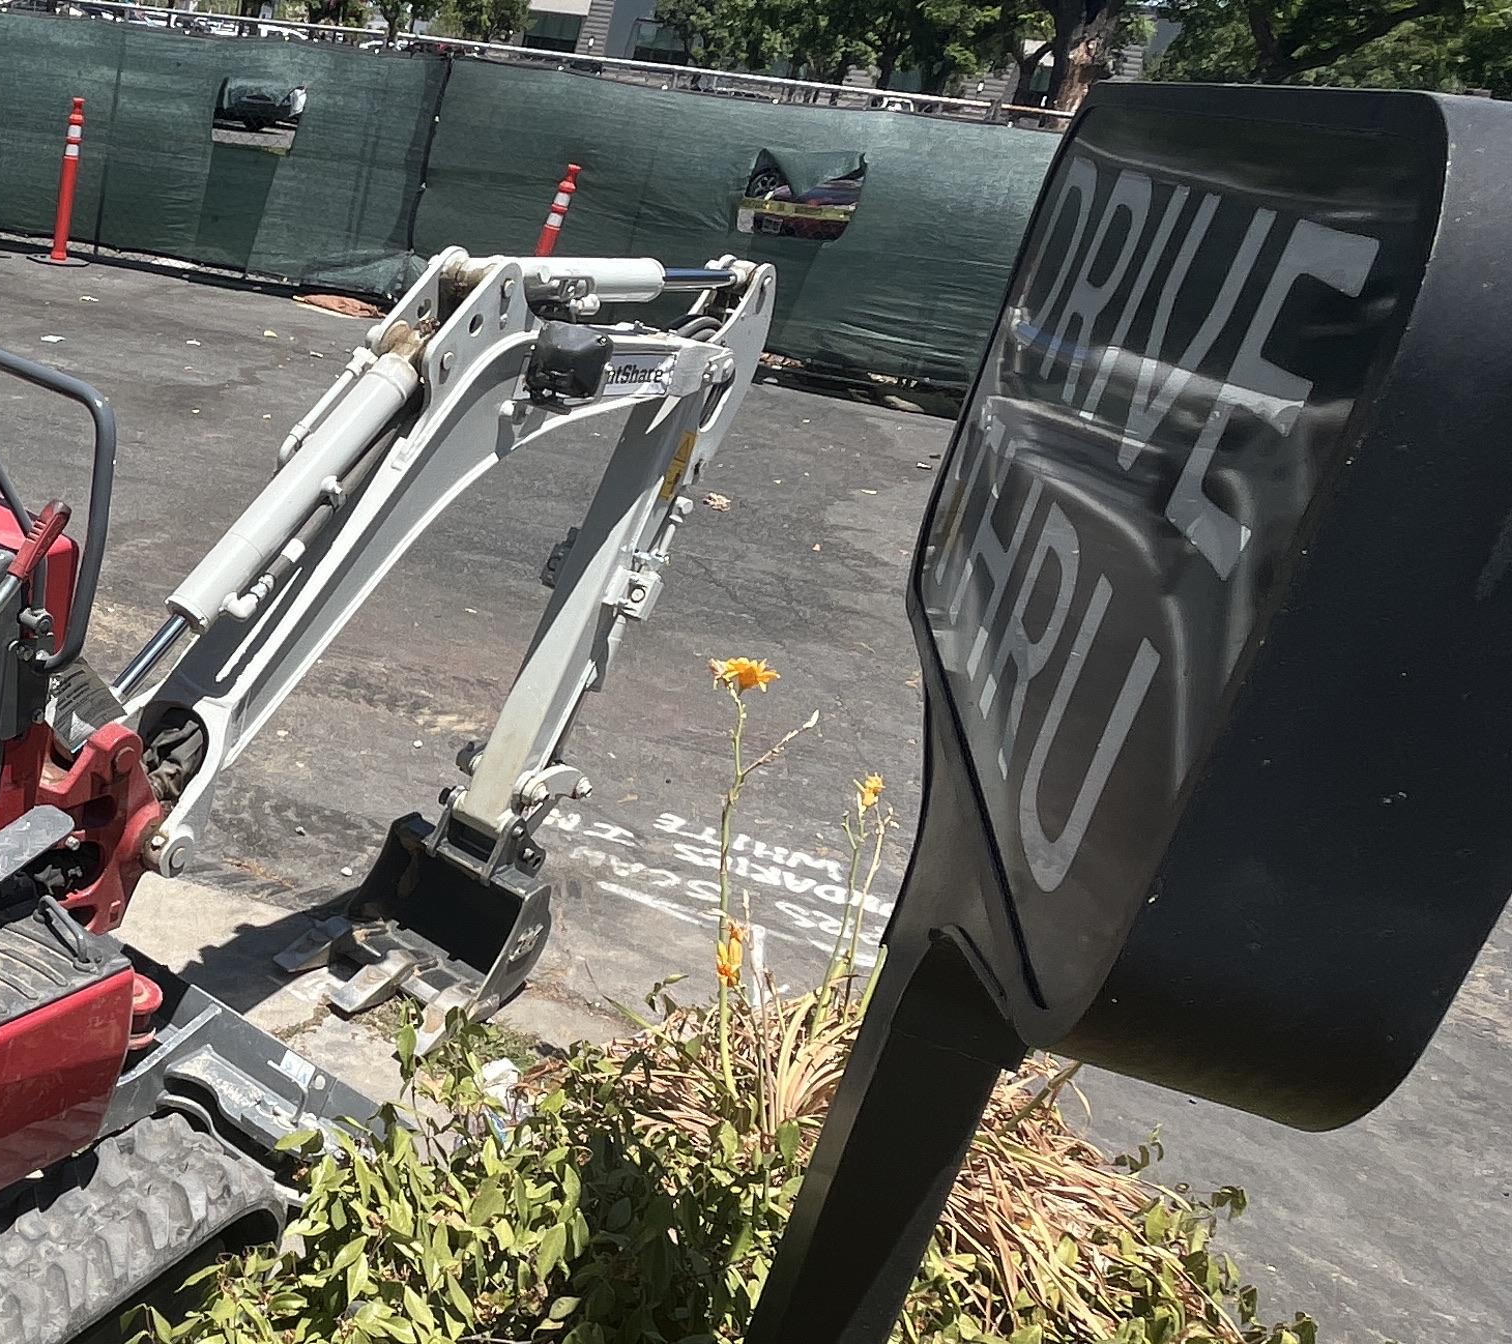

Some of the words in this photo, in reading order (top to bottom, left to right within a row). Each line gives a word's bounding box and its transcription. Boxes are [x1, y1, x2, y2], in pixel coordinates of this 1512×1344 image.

[1014, 154, 1381, 582] DRIVE
[653, 812, 844, 882] WHITE
[934, 416, 1162, 894] THRU
